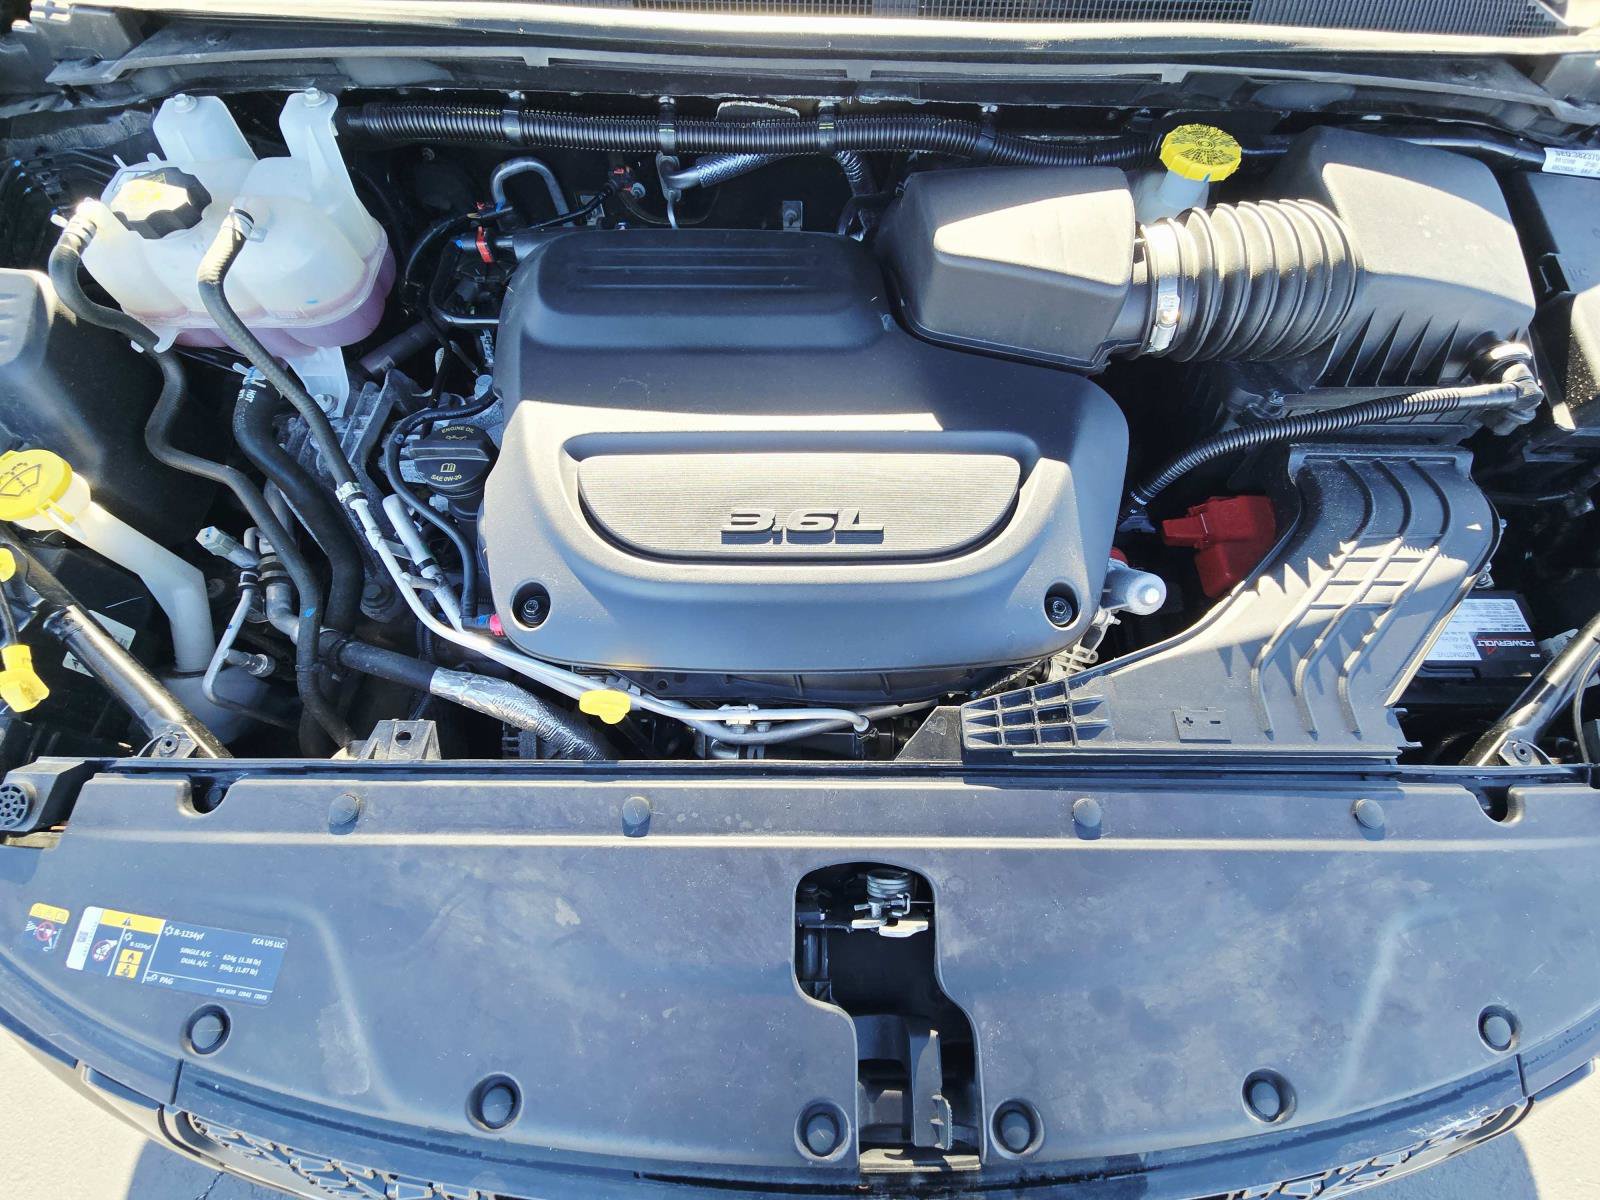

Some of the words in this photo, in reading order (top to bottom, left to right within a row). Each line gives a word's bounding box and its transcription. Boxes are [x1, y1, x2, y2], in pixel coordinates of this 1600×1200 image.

[430, 474, 443, 482] SAE
[720, 508, 885, 545] 3.6L
[173, 928, 205, 942] R-1234yf
[251, 937, 264, 946] FCA
[264, 939, 273, 948] US
[273, 940, 286, 949] LLC
[179, 947, 200, 956] SINGLE
[199, 949, 212, 958] A/C
[180, 957, 197, 966] DUAL
[197, 959, 208, 968] A/C
